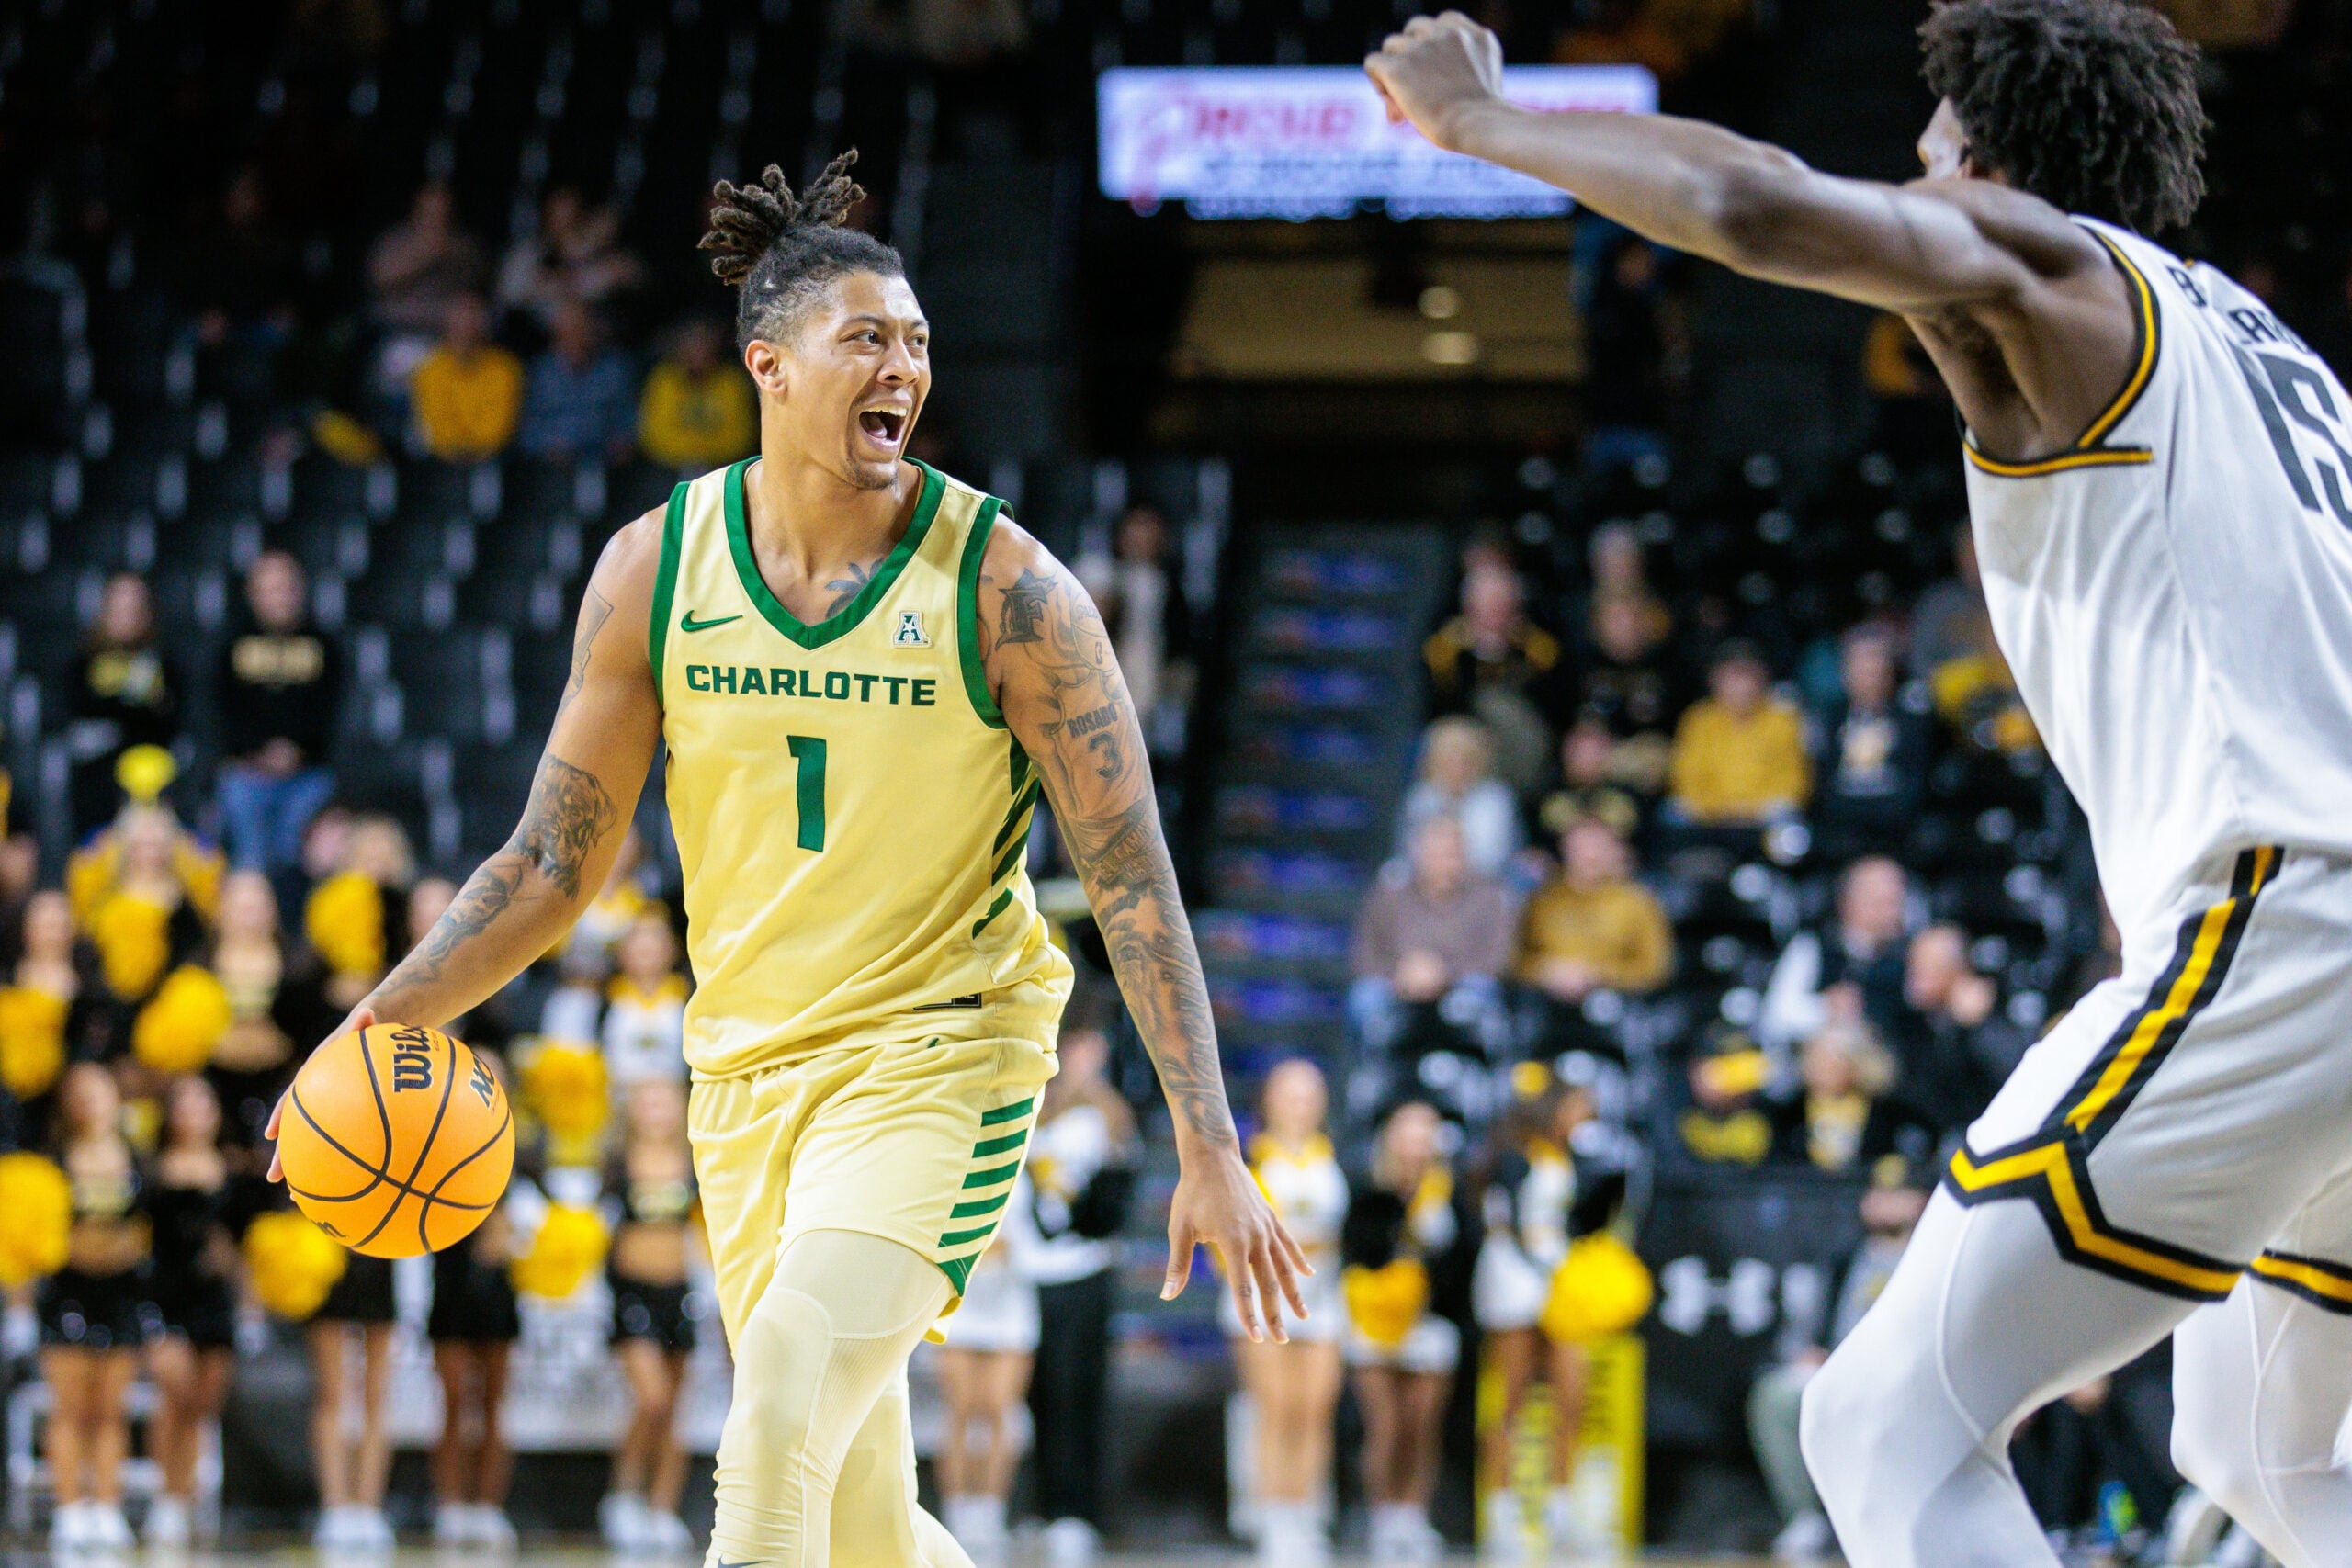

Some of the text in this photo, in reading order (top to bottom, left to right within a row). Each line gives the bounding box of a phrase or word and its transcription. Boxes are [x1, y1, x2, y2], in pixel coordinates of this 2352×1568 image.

[686, 664, 936, 706] CHARLOTTE
[1089, 731, 1124, 781] 3
[786, 735, 827, 852] 1
[469, 1052, 496, 1110] NC
